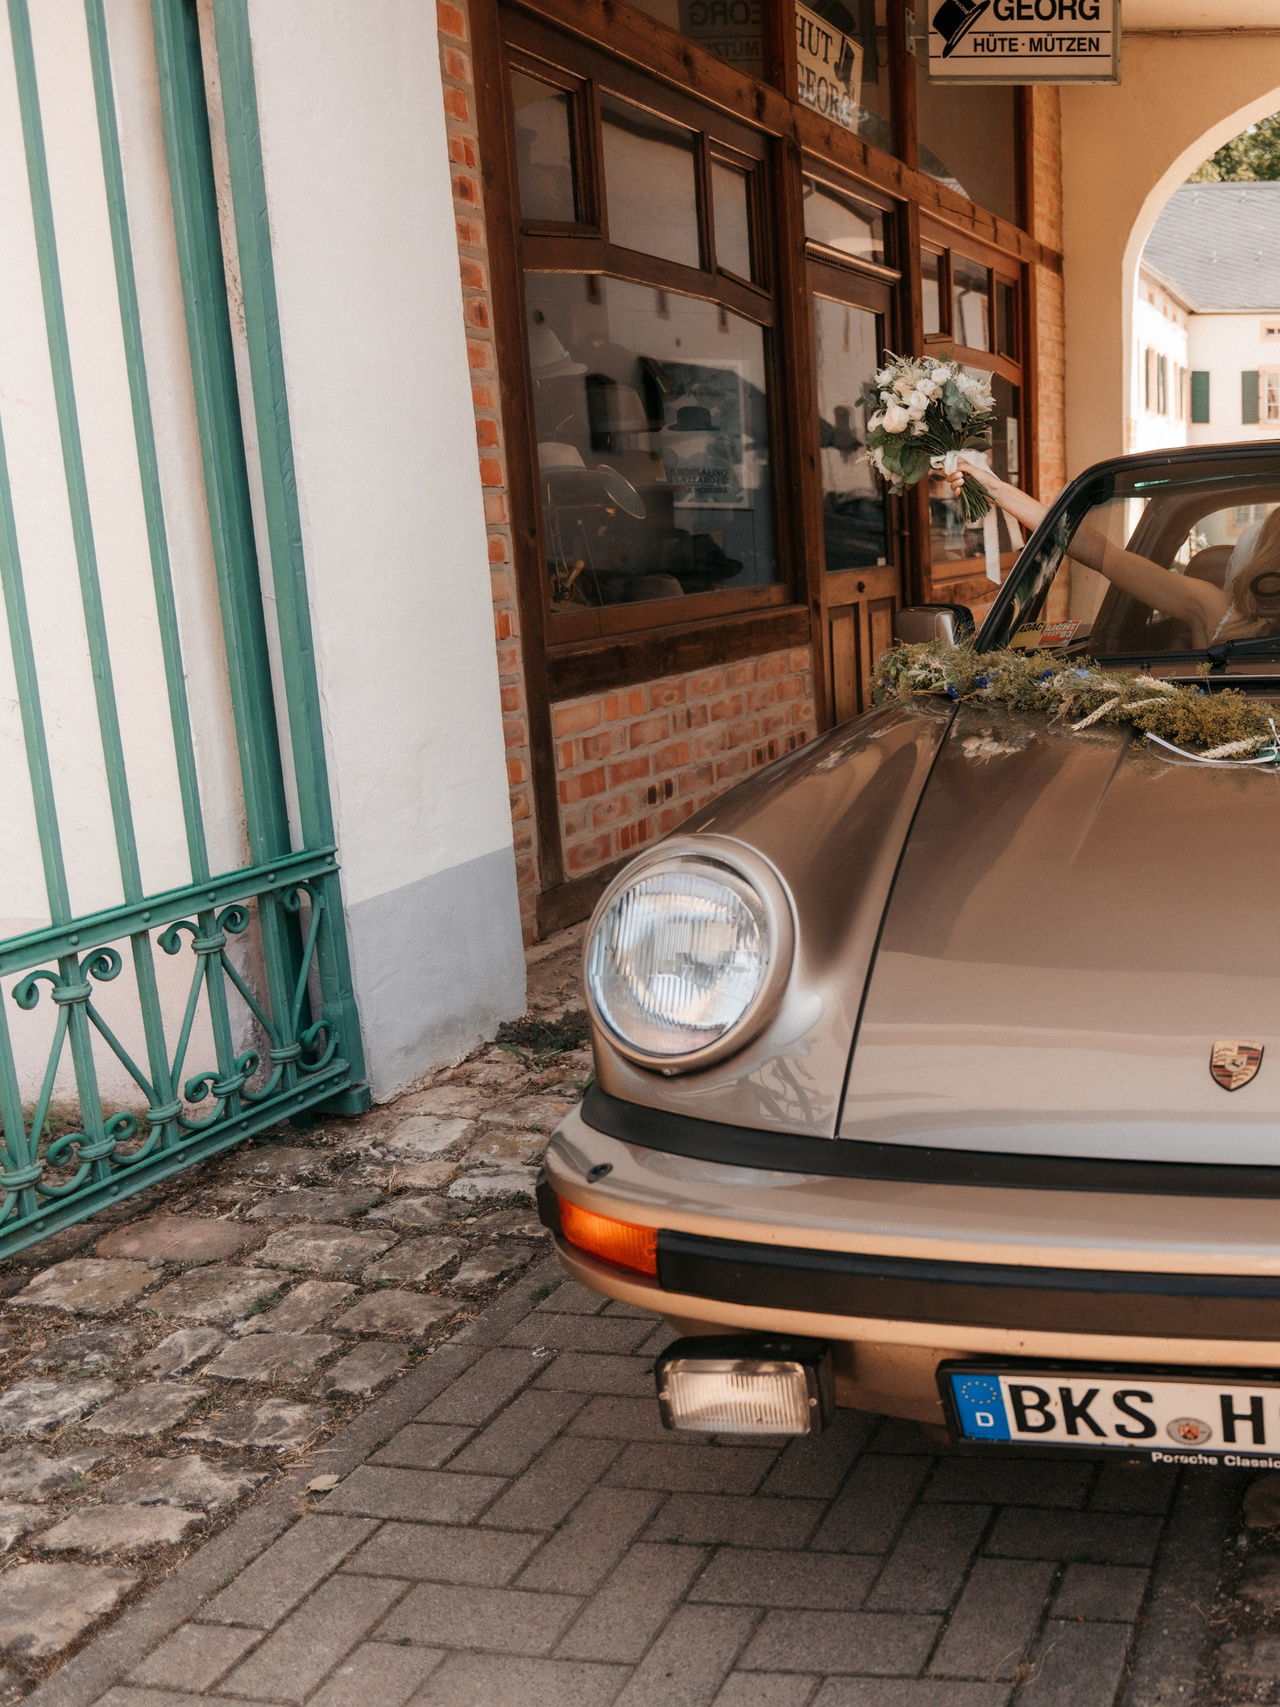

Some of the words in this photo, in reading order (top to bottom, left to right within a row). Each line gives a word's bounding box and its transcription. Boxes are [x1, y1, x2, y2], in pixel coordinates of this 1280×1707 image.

[993, 0, 1100, 21] GEORG
[973, 34, 1019, 52] HÜTE
[1029, 34, 1100, 52] MÜTZEN
[677, 468, 728, 477] BORSALINO
[1016, 623, 1045, 634] ADAC
[1045, 623, 1077, 632] LICHT
[1008, 1384, 1157, 1438] BKS
[975, 1412, 994, 1427] D
[1151, 1451, 1218, 1465] Porsche
